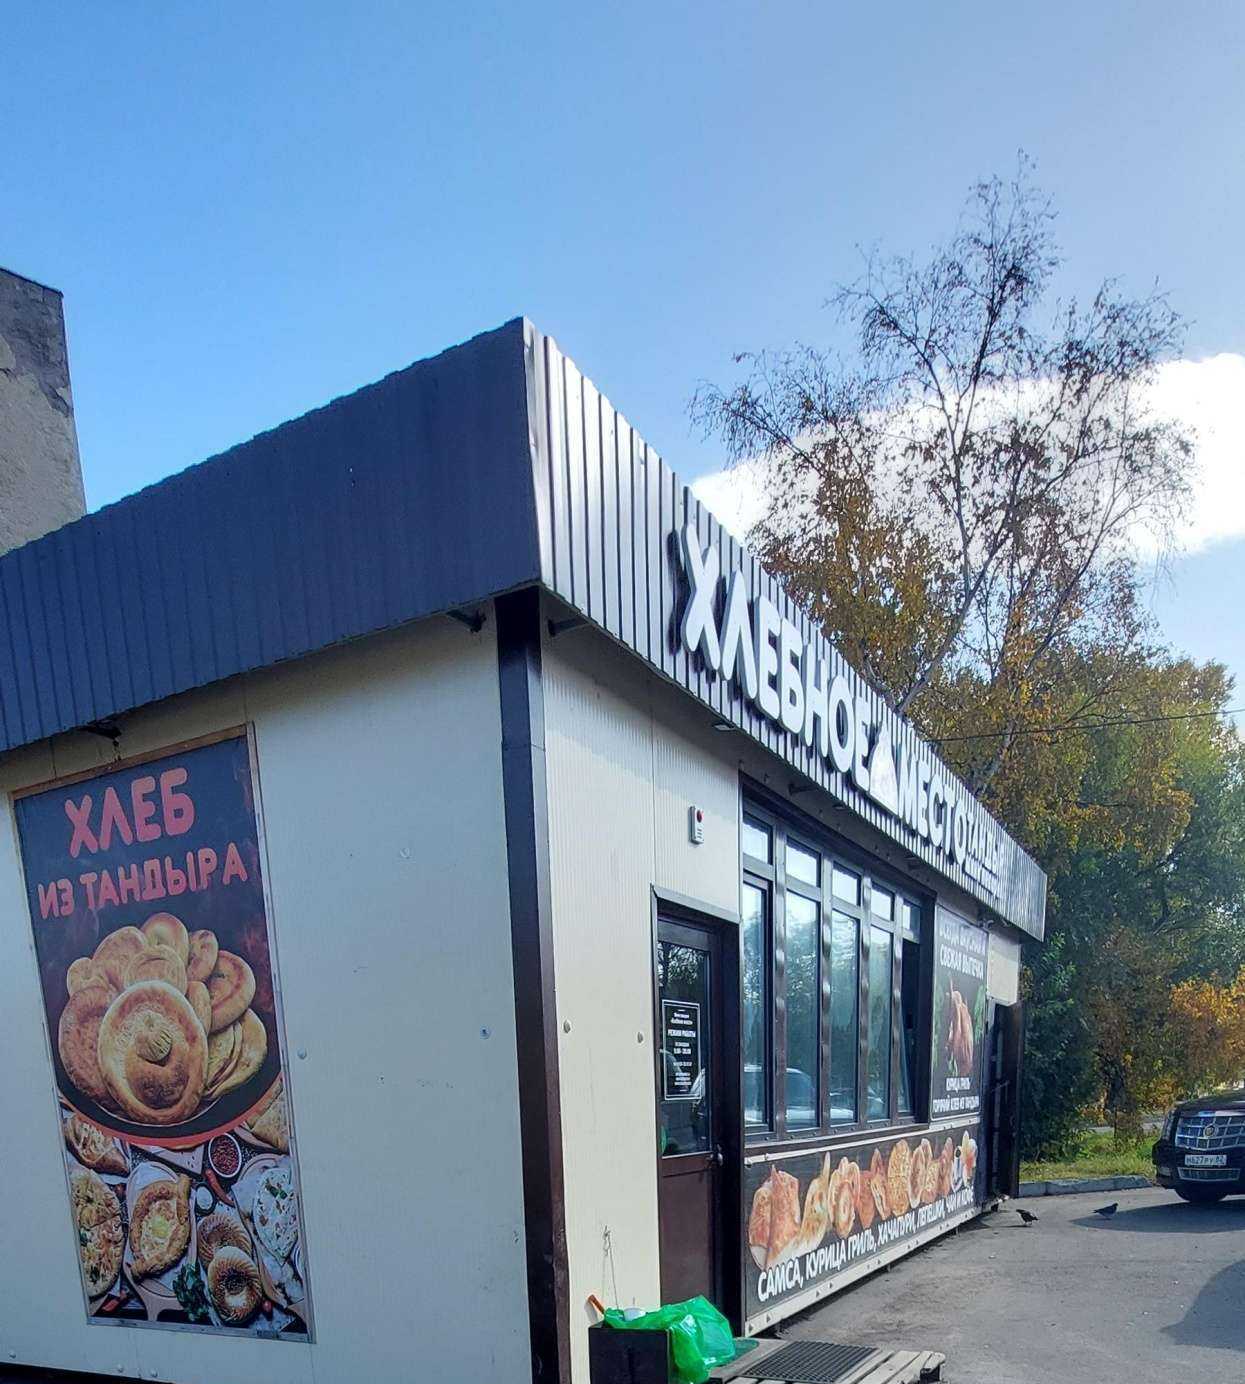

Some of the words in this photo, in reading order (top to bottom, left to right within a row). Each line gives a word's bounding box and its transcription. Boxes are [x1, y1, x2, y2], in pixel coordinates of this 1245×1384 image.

[682, 522, 872, 795] ХЛЕБНОЕ
[898, 737, 968, 866] МЕСТО
[64, 767, 195, 858] ХЛЕБ
[37, 878, 74, 920] ИЗ
[79, 841, 248, 911] ТАНДЫРА
[757, 1256, 804, 1302] САМСА,
[805, 1239, 847, 1280] КУРИЦА
[847, 1228, 877, 1253] ГРИЛЬ,
[877, 1210, 916, 1245] ХАЧАПУРИ,
